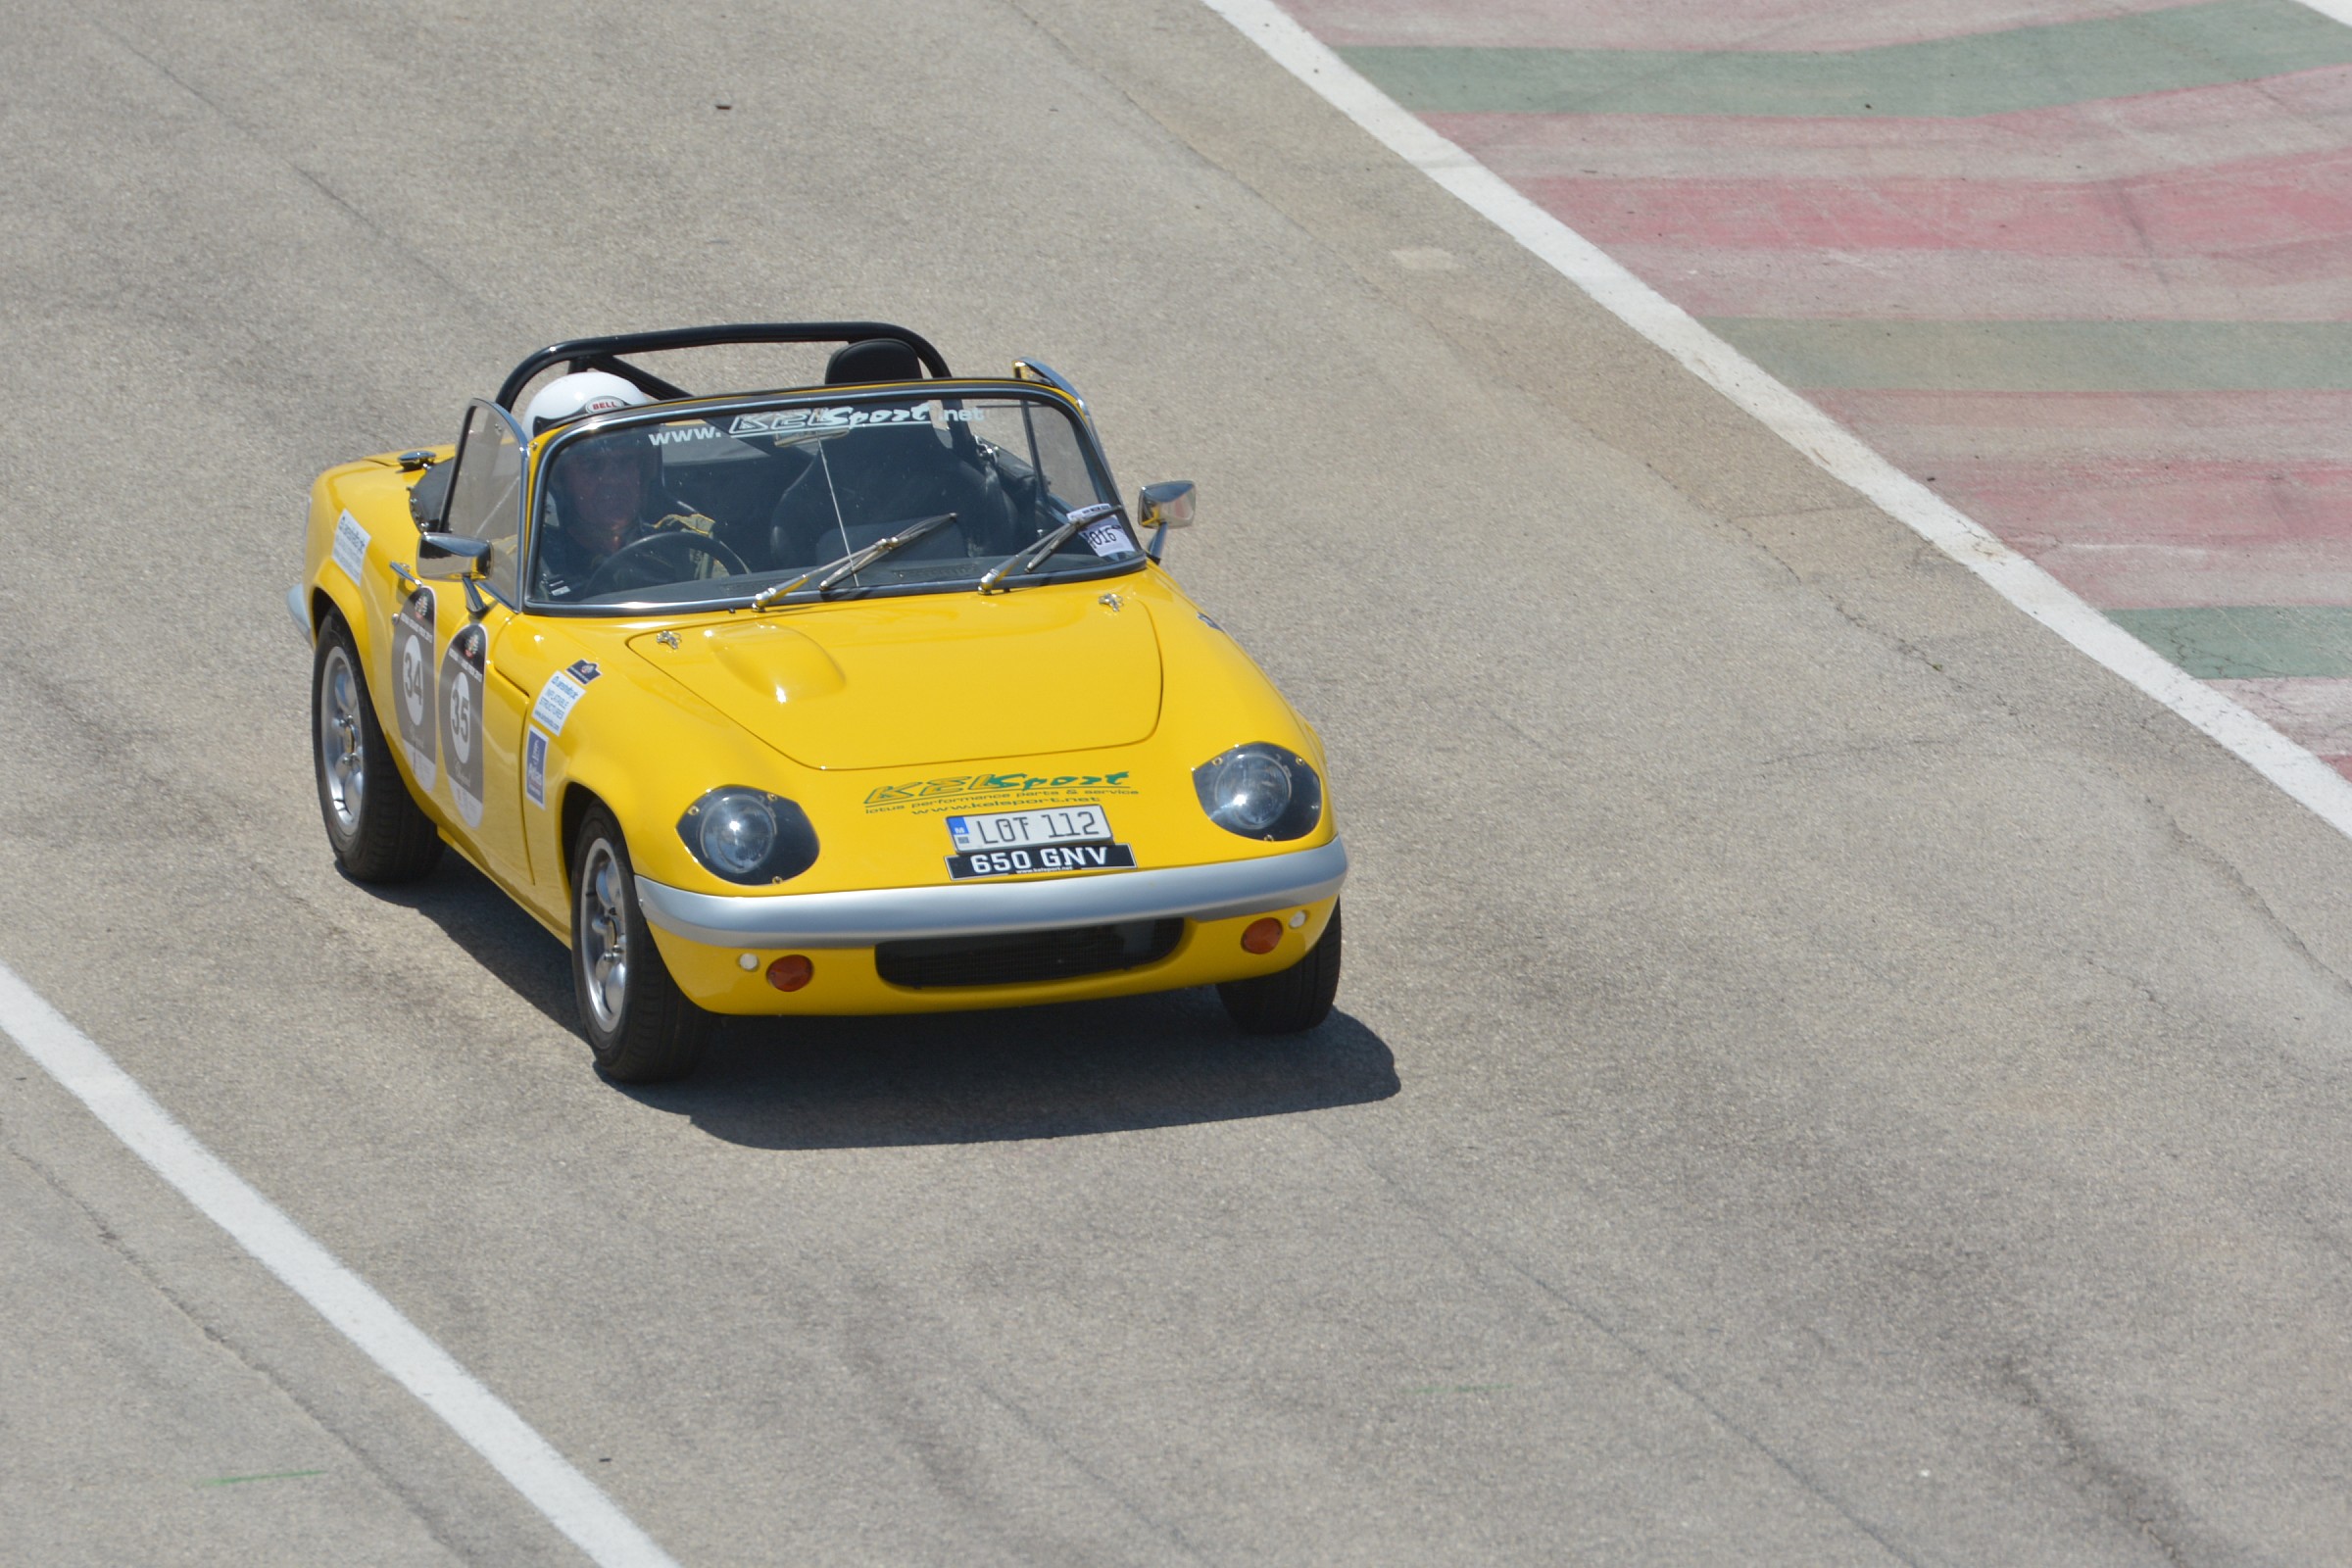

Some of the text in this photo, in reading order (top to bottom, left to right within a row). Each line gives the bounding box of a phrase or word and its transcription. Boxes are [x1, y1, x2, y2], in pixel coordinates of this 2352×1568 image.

[592, 401, 617, 411] BELL
[404, 652, 423, 707] 34
[451, 688, 469, 744] 35
[865, 804, 905, 814] lotus
[911, 793, 1011, 808] performance
[1016, 789, 1059, 798] parts
[911, 796, 1101, 815] www.kelsport.net
[1041, 810, 1100, 839] 112
[969, 846, 1107, 874] 650 GNV
